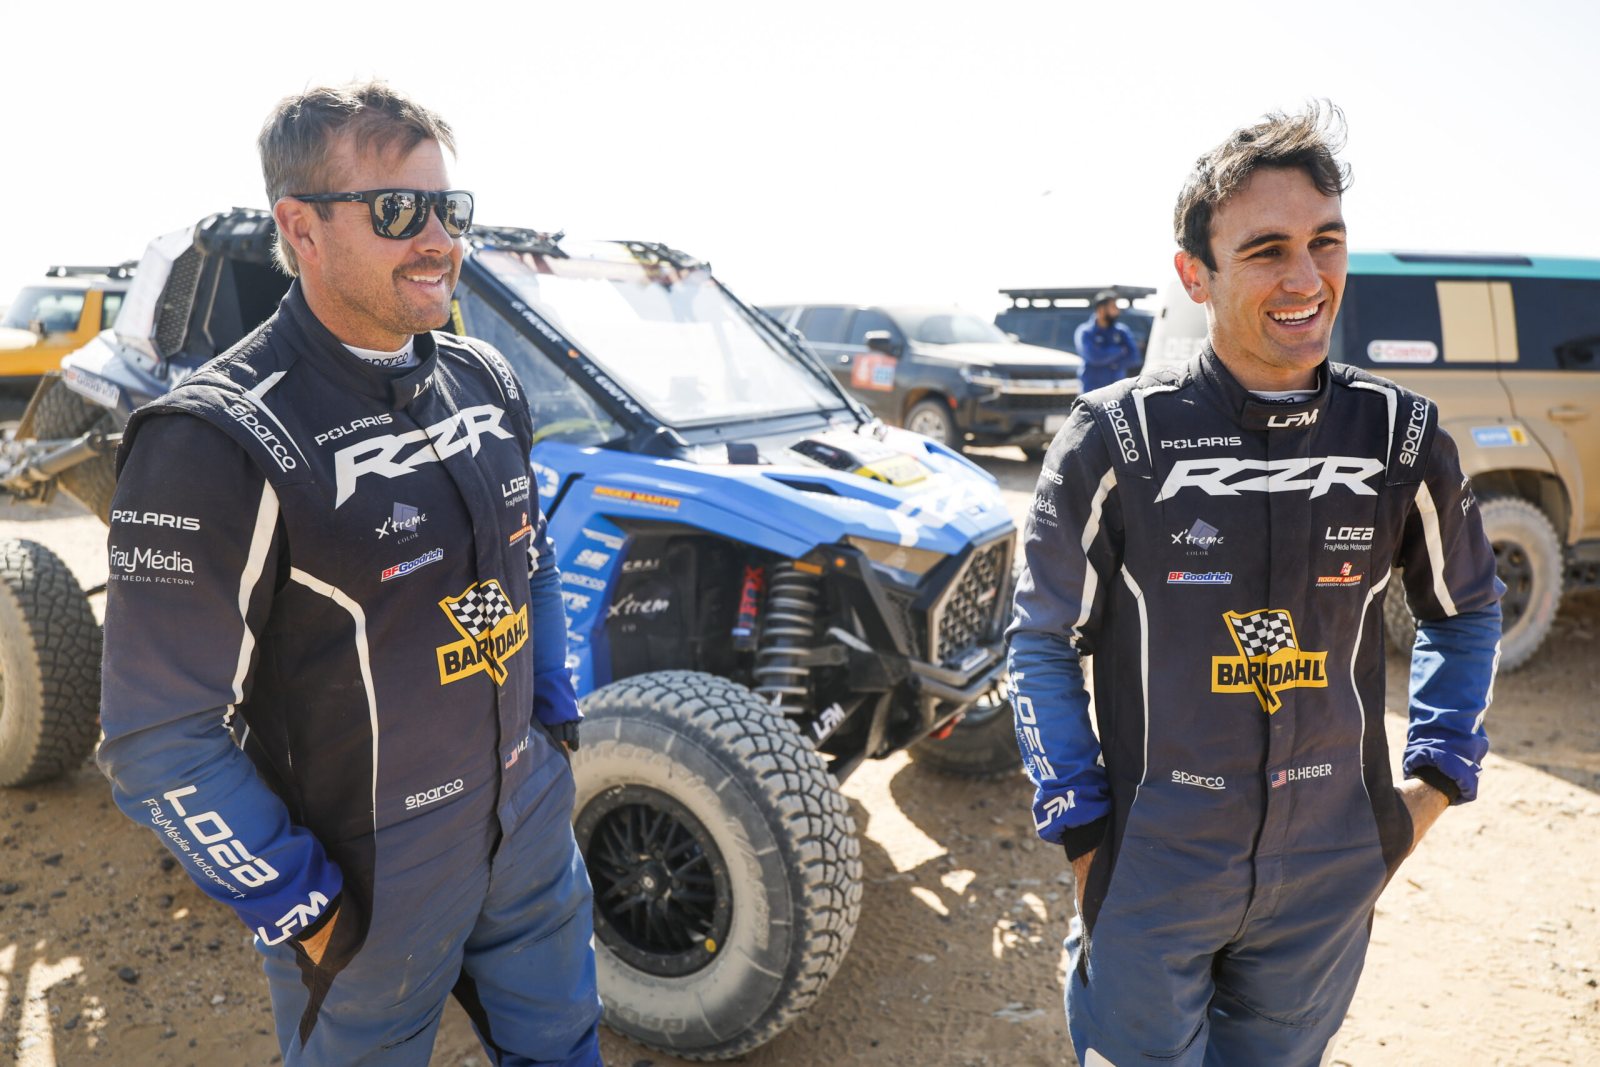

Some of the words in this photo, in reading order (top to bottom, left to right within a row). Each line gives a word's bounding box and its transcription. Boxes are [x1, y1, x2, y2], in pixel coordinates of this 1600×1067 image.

[314, 413, 393, 446] POLARIS
[1103, 400, 1140, 464] sparco
[1267, 409, 1319, 428] LFM
[1400, 401, 1430, 467] sparco
[223, 405, 297, 473] sparco
[1161, 436, 1242, 449] POLARIS
[1154, 456, 1384, 503] RZR
[112, 510, 200, 531] POLARIS
[1325, 526, 1375, 540] LOEB
[110, 545, 194, 573] FrayMédia
[381, 548, 443, 580] BFGoodrich
[121, 574, 152, 582] MEDIA
[155, 576, 195, 585] FACTORY
[1168, 572, 1232, 582] BFGoodrich
[443, 623, 527, 676] BARDAHL
[1217, 659, 1325, 686] BARDAHL
[1172, 770, 1226, 790] sparco
[1288, 764, 1332, 781] B.HEGER
[405, 779, 464, 810] sparco
[142, 798, 190, 852] FrayMédia
[188, 852, 248, 900] Motorsport
[163, 785, 279, 887] LOEB
[258, 891, 329, 946] LFM
